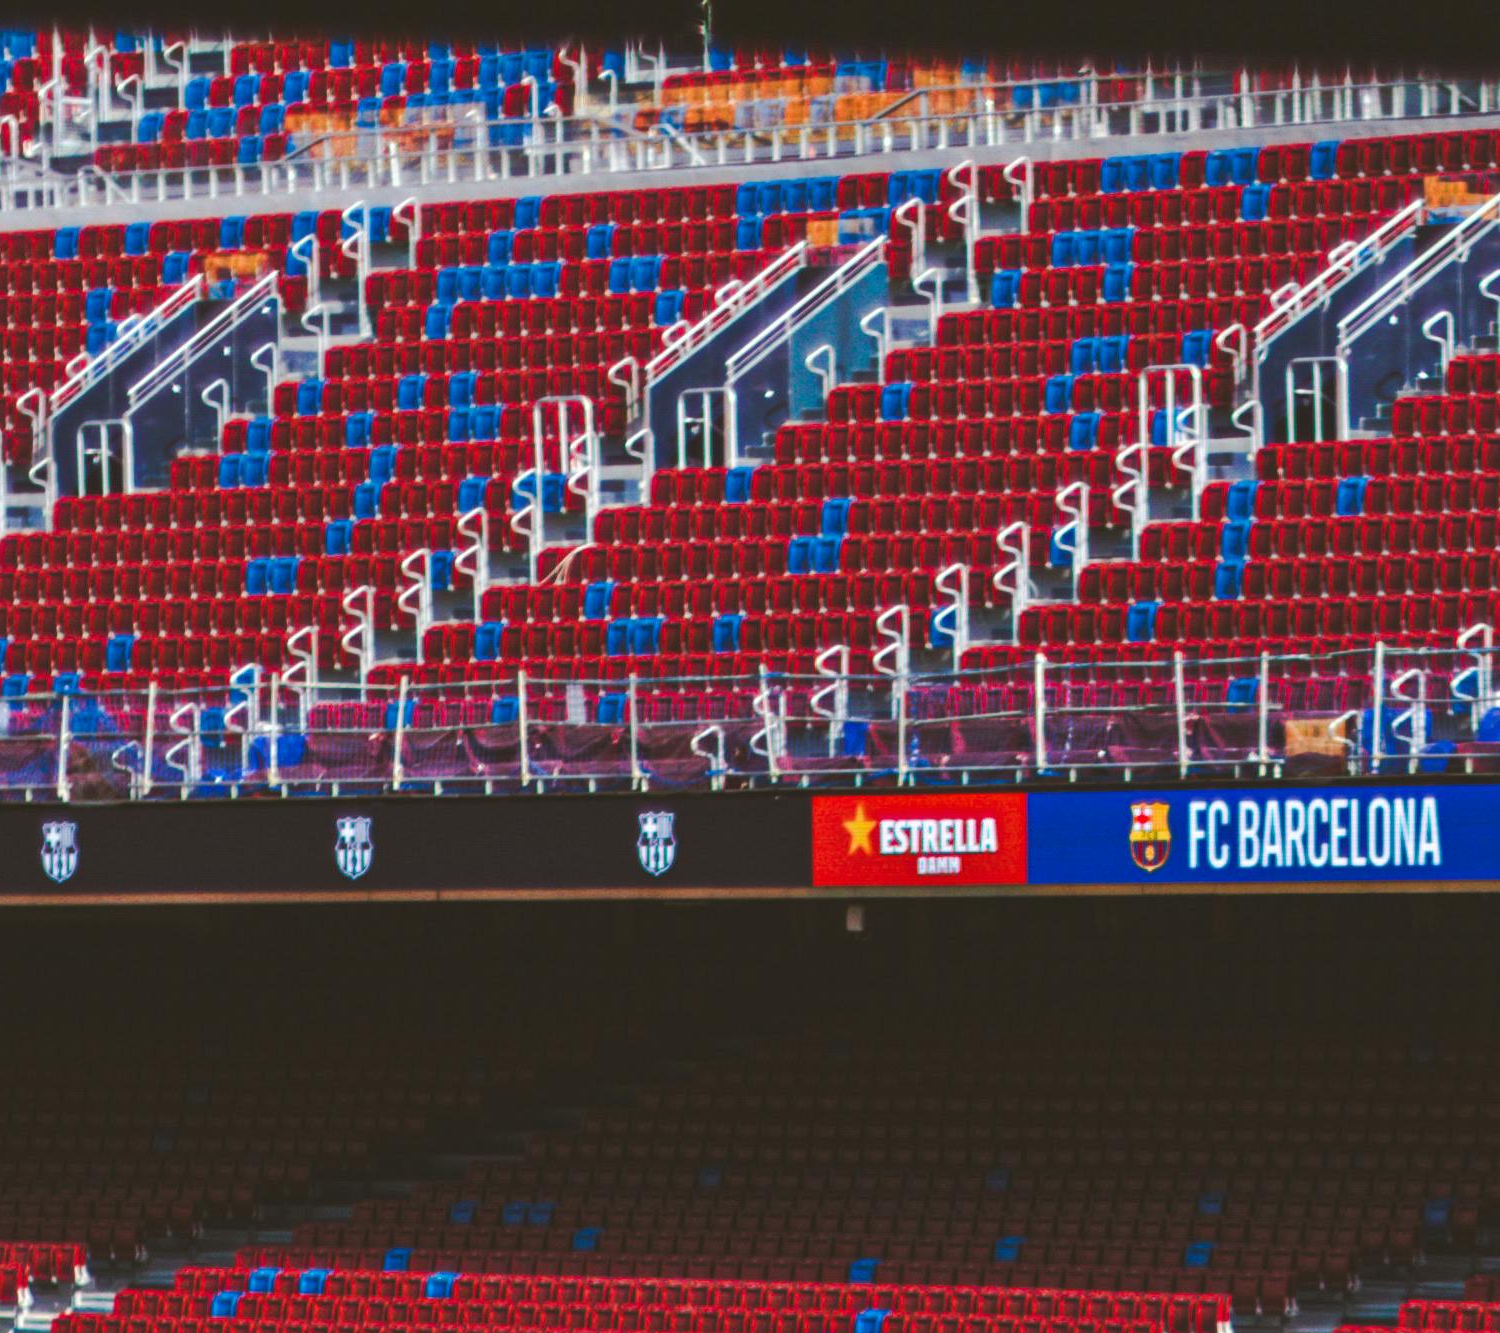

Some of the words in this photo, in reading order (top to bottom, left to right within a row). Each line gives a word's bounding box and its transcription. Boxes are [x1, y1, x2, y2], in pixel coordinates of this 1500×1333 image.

[879, 817, 998, 854] ESTRELLA
[1188, 799, 1229, 869] FC
[1238, 796, 1441, 868] BARCELONA
[917, 856, 961, 875] DAMM
